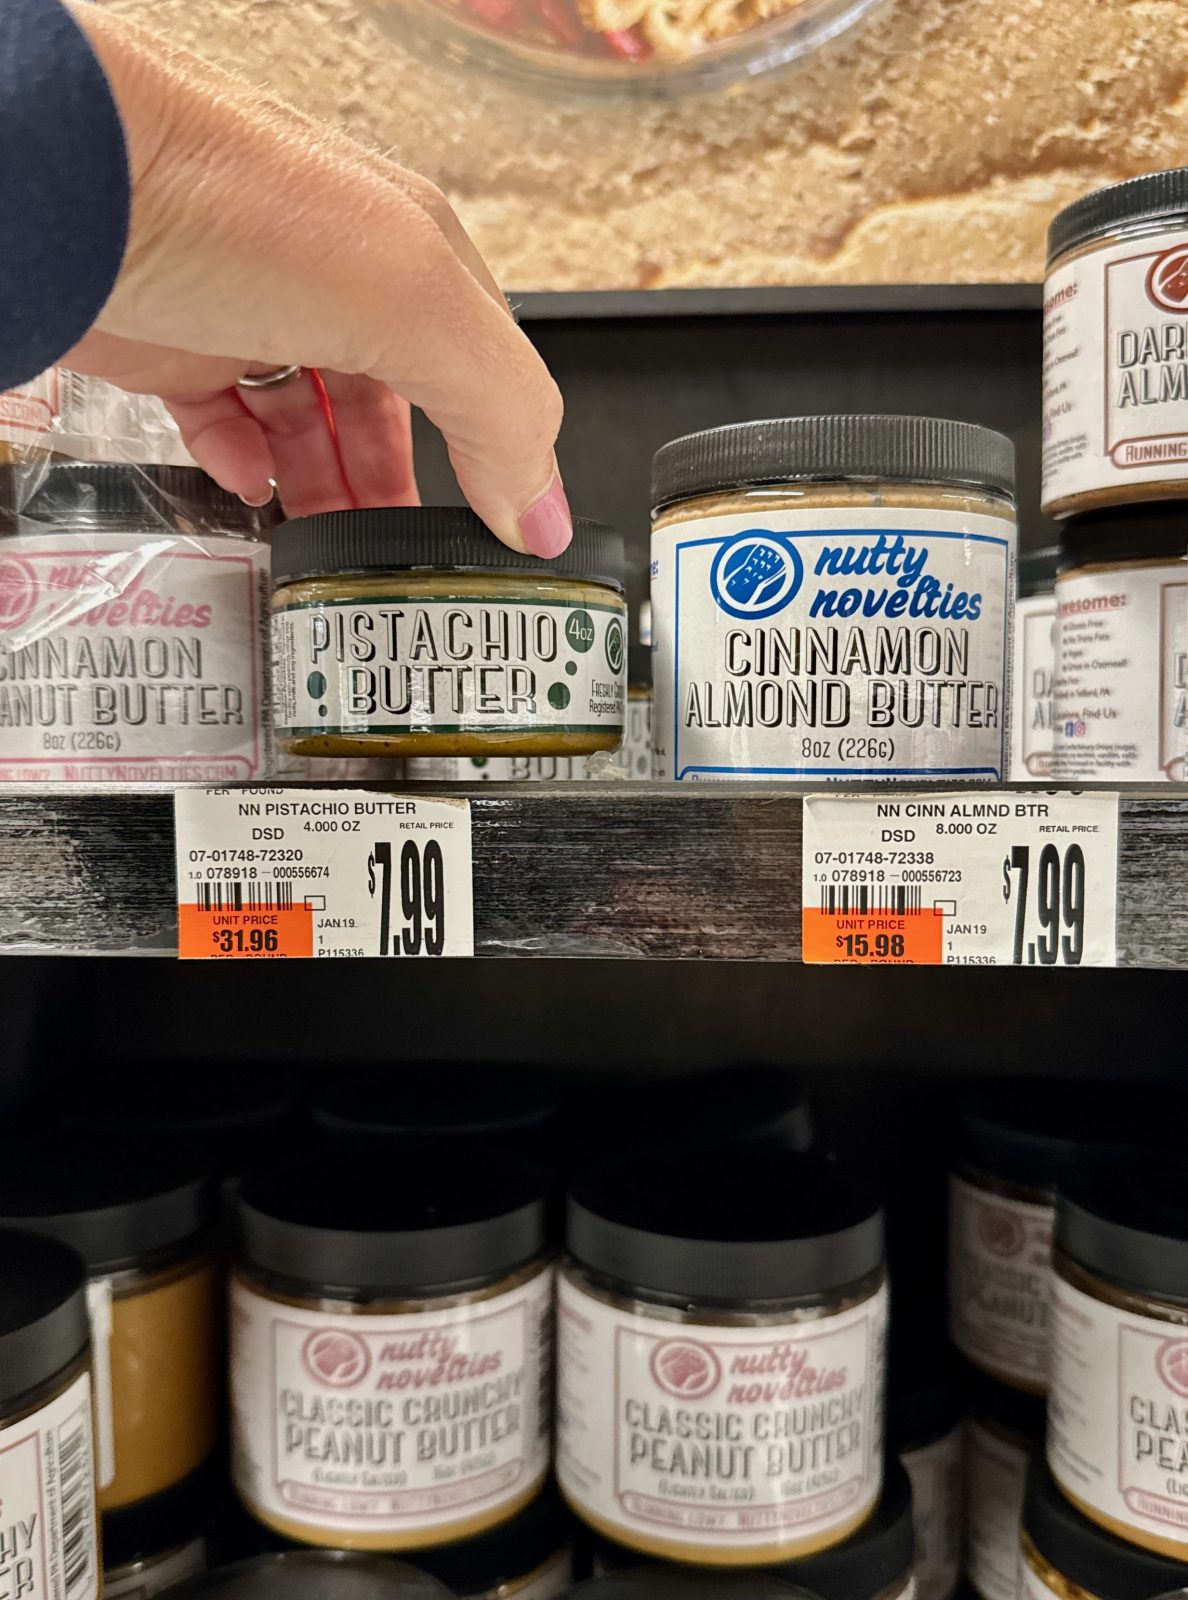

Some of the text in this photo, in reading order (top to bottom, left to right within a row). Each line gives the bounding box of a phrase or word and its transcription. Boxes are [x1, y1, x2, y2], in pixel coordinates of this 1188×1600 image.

[1117, 323, 1188, 368] DAR
[813, 534, 929, 588] nutty
[808, 575, 983, 621] novelties
[309, 607, 557, 664] PISTACHIO
[724, 626, 969, 677] CINNAMON
[93, 684, 243, 726] BUTTER
[346, 664, 538, 715] BUTTER
[685, 680, 850, 729] ALMOND
[866, 680, 999, 729] BUTTER
[1103, 706, 1117, 719] Us
[238, 802, 416, 816] NN PISTACHIO BUTTER
[303, 821, 361, 832] 4.000 OZ
[877, 804, 1049, 817] NN CINN ALMND BTR
[252, 828, 285, 840] DSD
[881, 830, 915, 842] DSD
[936, 823, 997, 835] 8.000 OZ
[1039, 825, 1099, 833] RETAIL PRICE
[188, 872, 202, 880] 1.0
[206, 867, 258, 879] 078918
[273, 866, 330, 879] 000556674
[189, 850, 304, 862] 07-01748-72320
[814, 852, 934, 865] 07-01748-72338
[813, 874, 827, 882] 1.0
[832, 870, 885, 882] 078918
[901, 870, 962, 882] 000556723
[368, 839, 445, 957] $7.99
[1003, 843, 1085, 965] $7.99
[212, 916, 279, 925] UNIT PRICE
[836, 920, 905, 930] UNIT PRICE
[212, 929, 278, 952] $31.96
[836, 934, 905, 957] $15.98
[379, 1331, 458, 1366] nutty
[730, 1345, 808, 1380] nutty
[376, 1350, 504, 1391] novelties
[726, 1365, 848, 1404] novelties
[280, 1368, 523, 1428] CLASSIC CRUNCHY
[625, 1384, 864, 1442] CLASSIC CRUNCHY
[1130, 1395, 1188, 1435] CLA
[285, 1422, 406, 1466] PEANUT
[416, 1404, 520, 1463] BUTTER
[630, 1420, 862, 1479] PEANUT BUTTER
